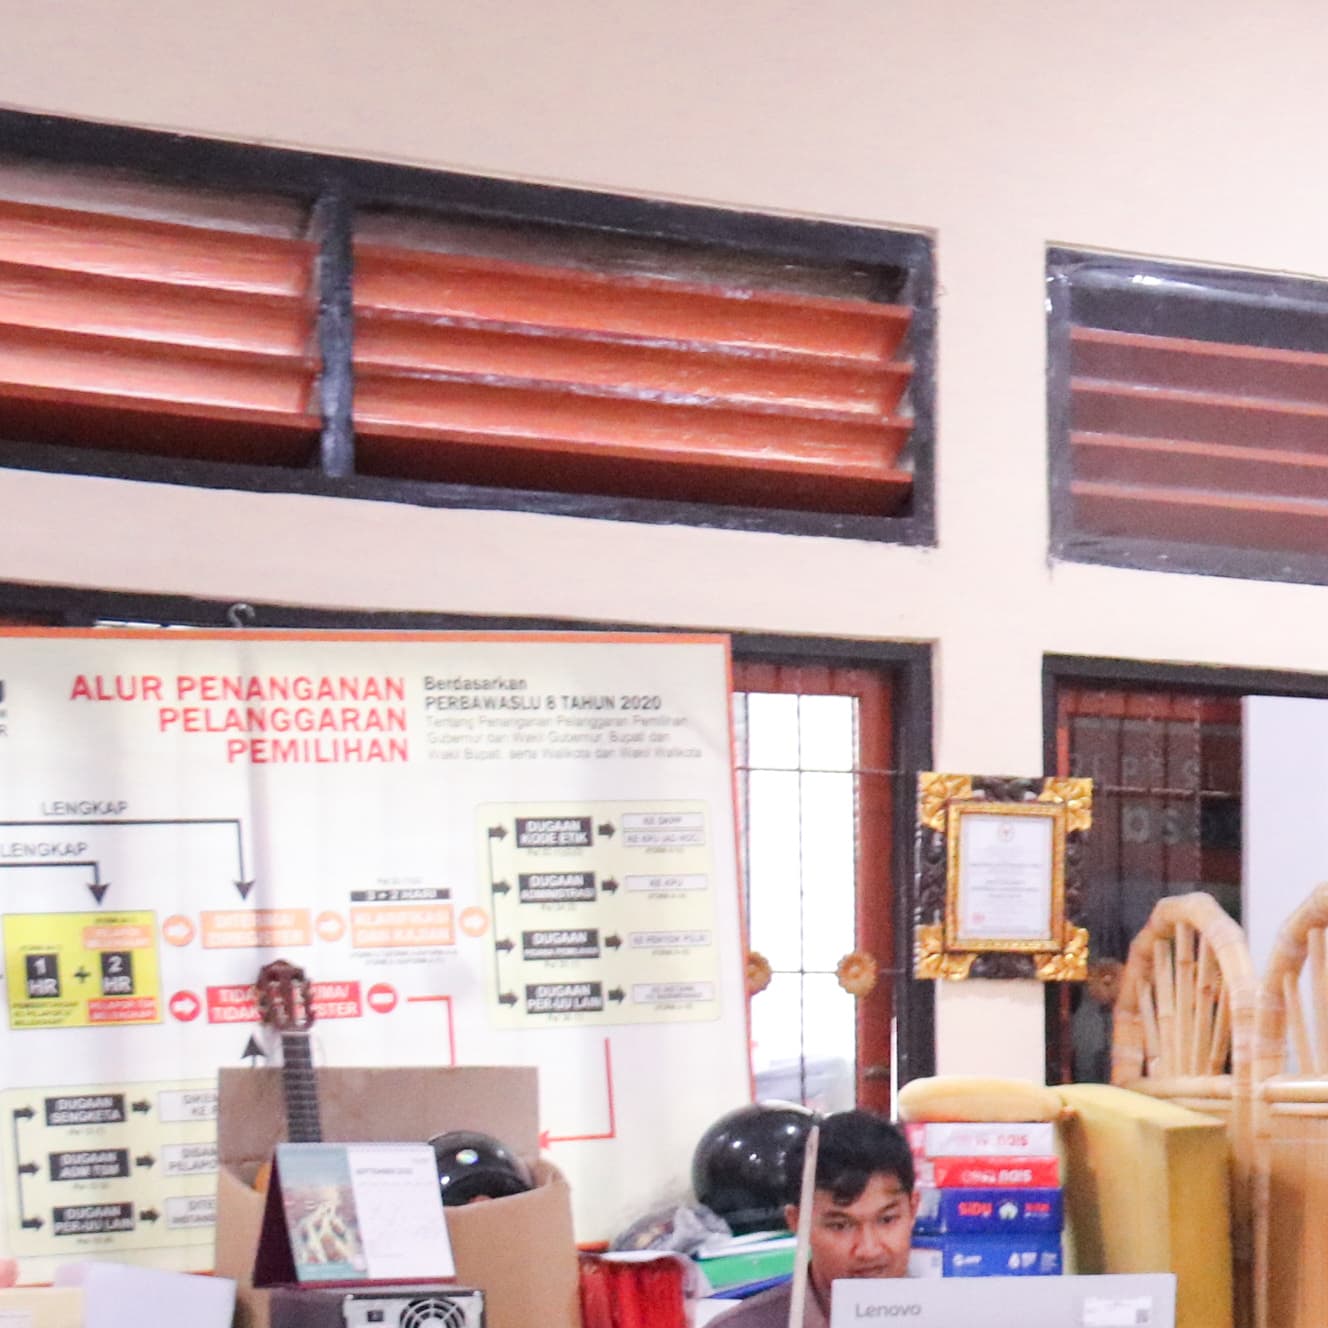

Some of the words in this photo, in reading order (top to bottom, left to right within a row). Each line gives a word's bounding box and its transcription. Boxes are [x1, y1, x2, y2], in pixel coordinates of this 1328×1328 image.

[70, 674, 163, 701] ALUR
[176, 675, 405, 702] PENANGANAN
[424, 675, 528, 691] Berdasarkan
[425, 695, 540, 710] PERBAWASLU
[561, 695, 616, 710] TAHUN
[620, 695, 662, 710] 2020
[158, 706, 408, 733] PELANGGARAN
[227, 737, 410, 764] PEMILIHAN
[42, 800, 128, 816] LENGKAP
[0, 841, 89, 858] LENGKAP
[33, 957, 47, 975] 1
[107, 955, 123, 974] 2
[27, 977, 58, 995] HR
[102, 975, 132, 993] HR
[855, 1302, 922, 1319] Lenovo
